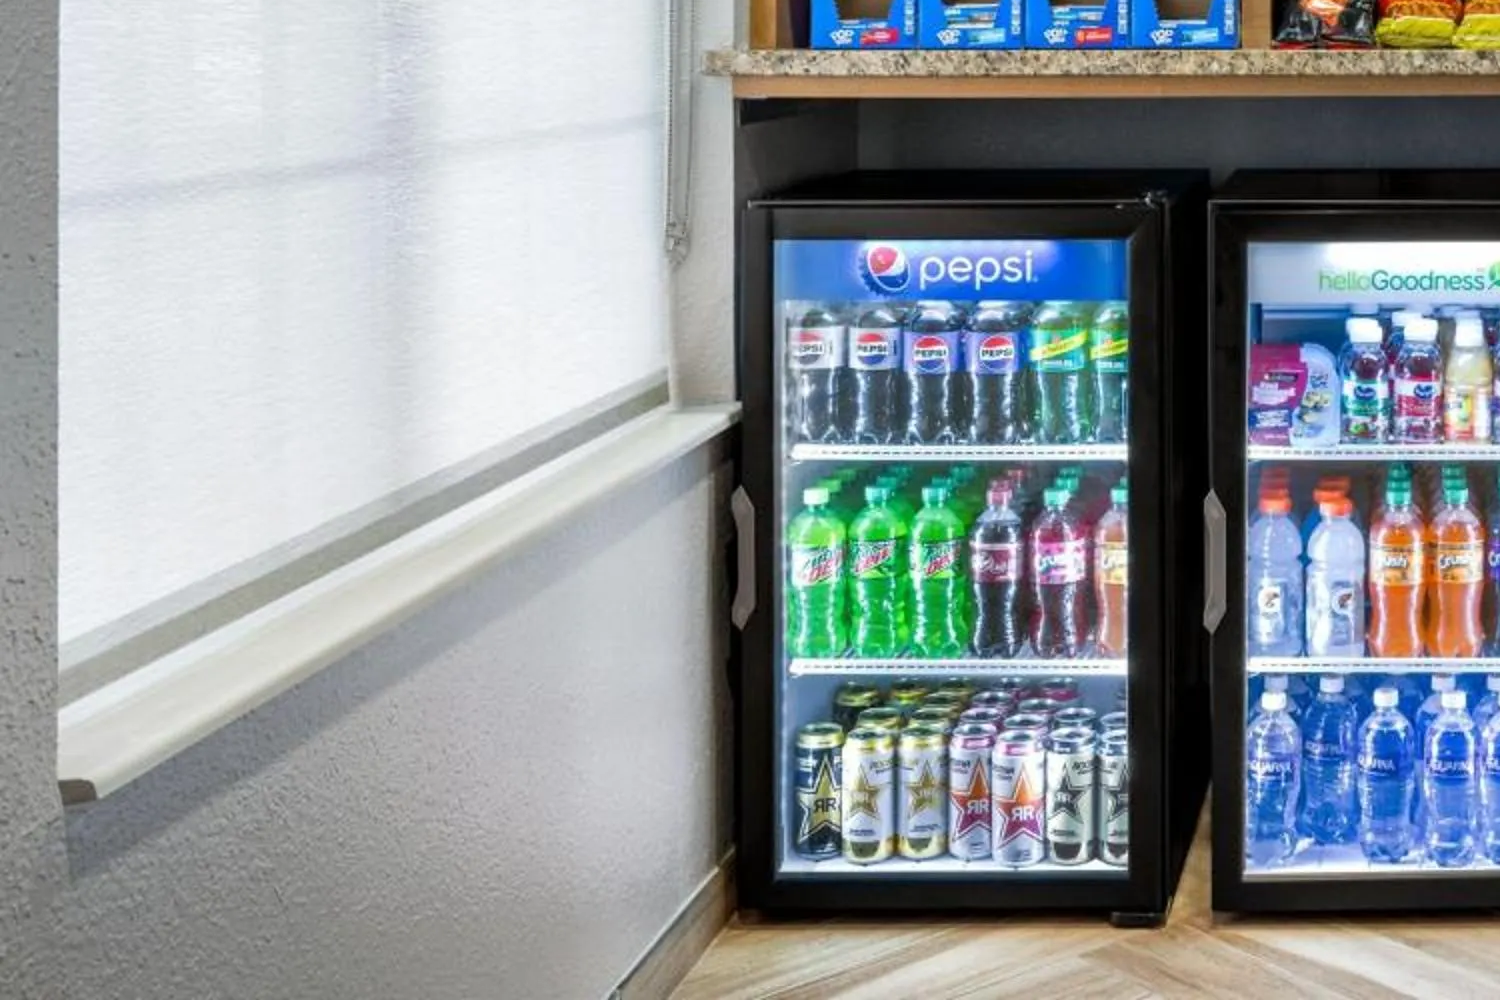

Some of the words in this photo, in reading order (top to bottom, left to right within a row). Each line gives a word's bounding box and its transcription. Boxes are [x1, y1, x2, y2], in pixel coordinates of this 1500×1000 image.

[919, 249, 1033, 291] pepsi
[857, 344, 887, 353] PEPSI
[981, 347, 1013, 358] PEPSI
